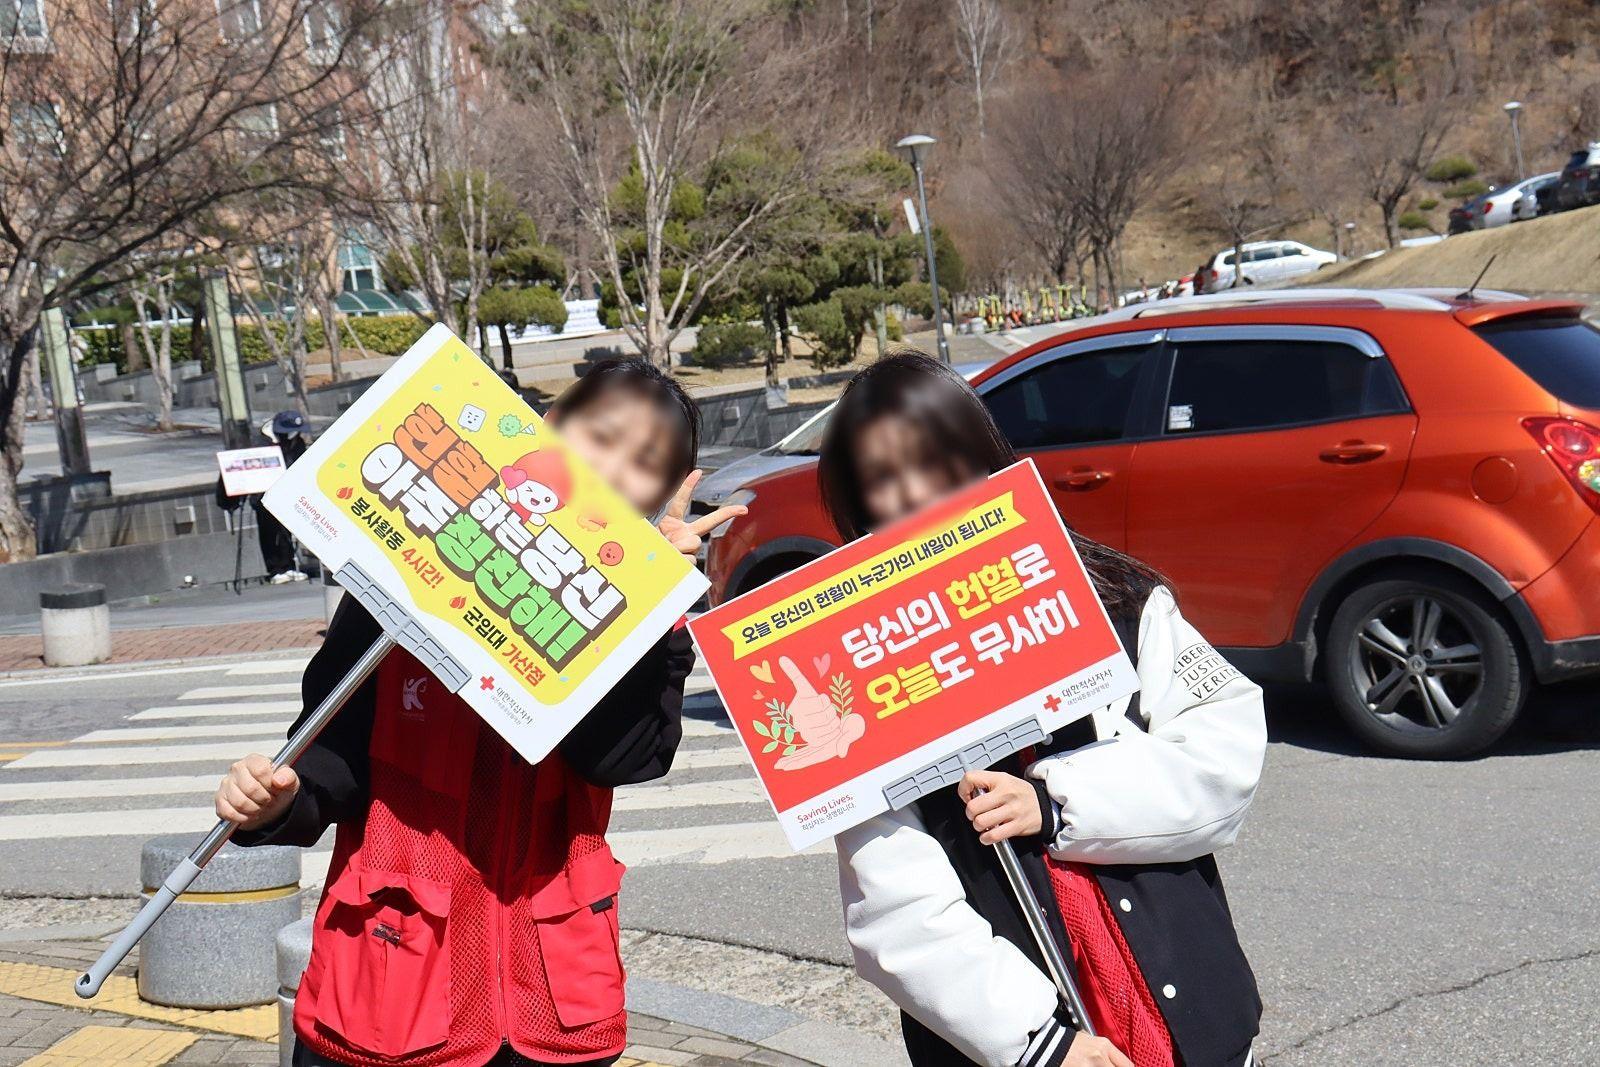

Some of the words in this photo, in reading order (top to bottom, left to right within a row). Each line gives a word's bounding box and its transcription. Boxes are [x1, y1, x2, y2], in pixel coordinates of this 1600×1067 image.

[298, 496, 321, 520] Saving
[350, 496, 406, 551] 봉사활동
[401, 547, 445, 589] 4시간!
[742, 621, 772, 644] 오늘
[770, 598, 816, 629] 당신의
[814, 577, 859, 609] 헌혈이
[858, 550, 916, 587] 누군가의
[914, 530, 959, 561] 내일이
[957, 507, 1007, 541] 됩니다!
[841, 591, 952, 670] 당신의
[945, 543, 1057, 620] 헌혈로
[462, 605, 508, 650] 군입대
[502, 643, 546, 687] 가산점
[866, 641, 975, 720] 오늘도
[969, 589, 1080, 666] 무사히
[1061, 668, 1113, 698] 대한적십자사
[797, 805, 828, 824] Saving
